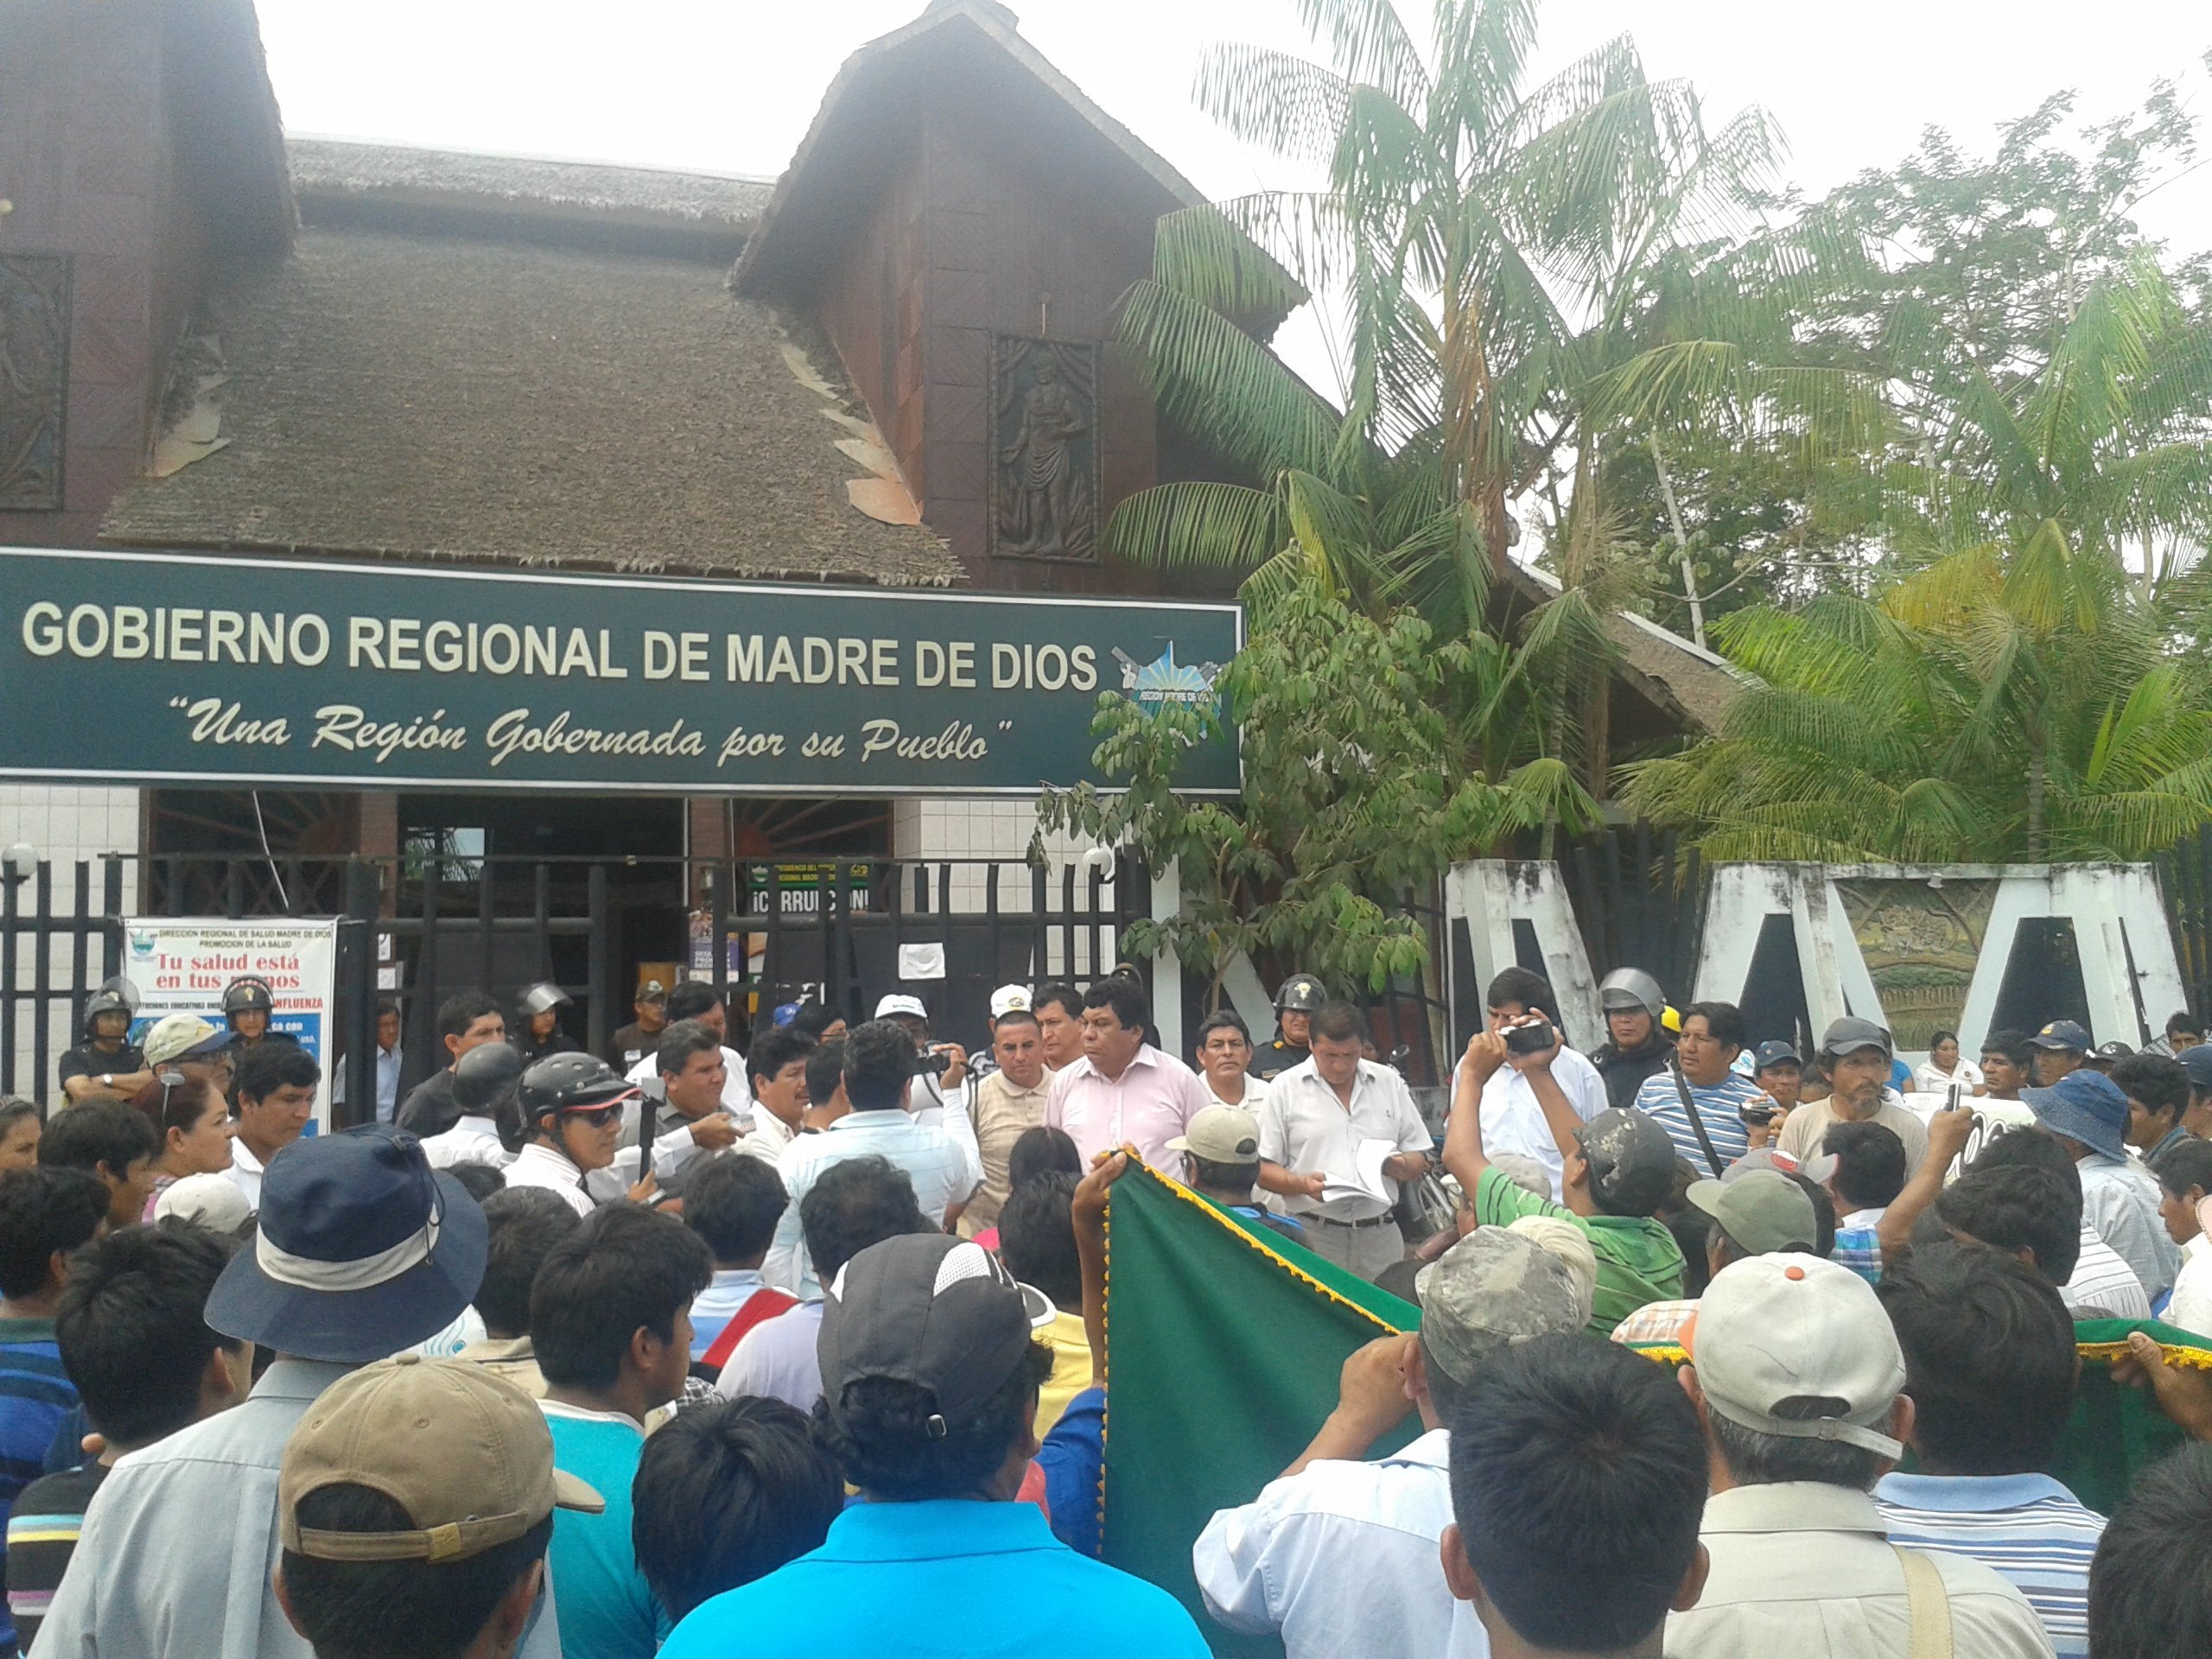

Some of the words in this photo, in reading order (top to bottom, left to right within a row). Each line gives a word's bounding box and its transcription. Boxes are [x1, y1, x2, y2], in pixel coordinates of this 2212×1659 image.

[22, 601, 330, 666] GOBIERNO
[349, 616, 628, 678] REGIONAL
[644, 630, 710, 681] DE
[727, 633, 899, 685] MADRE
[916, 640, 976, 688] DE
[992, 643, 1097, 691] DIOS
[311, 704, 467, 763] Región
[486, 708, 707, 766] Gobernada
[717, 726, 785, 767] por
[801, 732, 845, 758] su
[200, 930, 237, 938] REGIONAL
[157, 953, 182, 969] Tu
[191, 953, 248, 969] salud
[256, 952, 299, 969] está
[156, 976, 181, 988] en
[189, 973, 221, 988] tus
